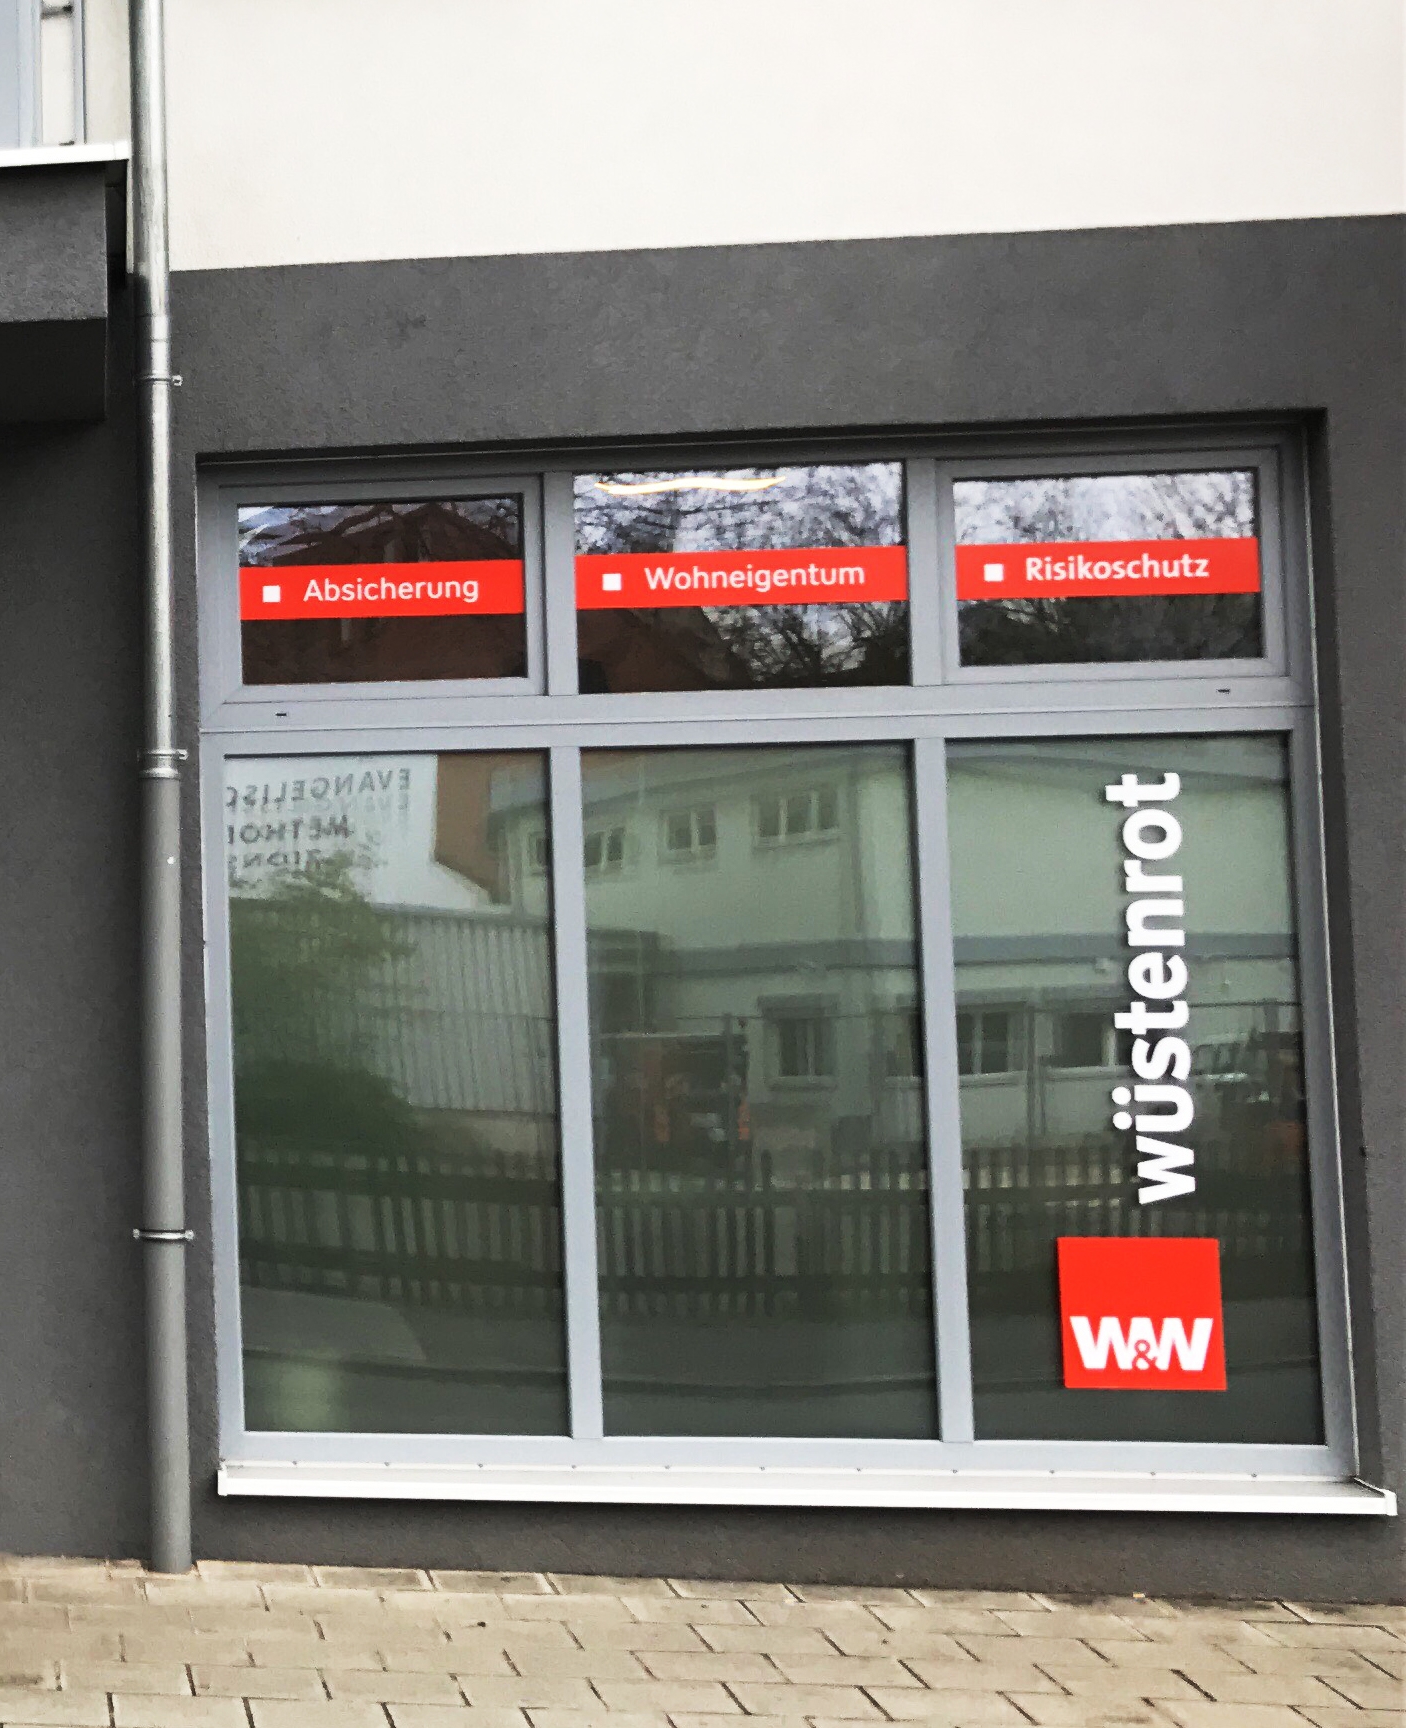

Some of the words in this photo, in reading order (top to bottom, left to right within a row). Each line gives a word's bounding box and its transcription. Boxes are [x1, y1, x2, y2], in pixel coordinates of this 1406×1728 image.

[644, 563, 865, 593] Wohneigentum
[1026, 553, 1209, 581] Risikoschutz
[302, 576, 480, 604] Absicherung
[1105, 773, 1196, 1204] wüstenrot
[1069, 1315, 1214, 1371] W&W
